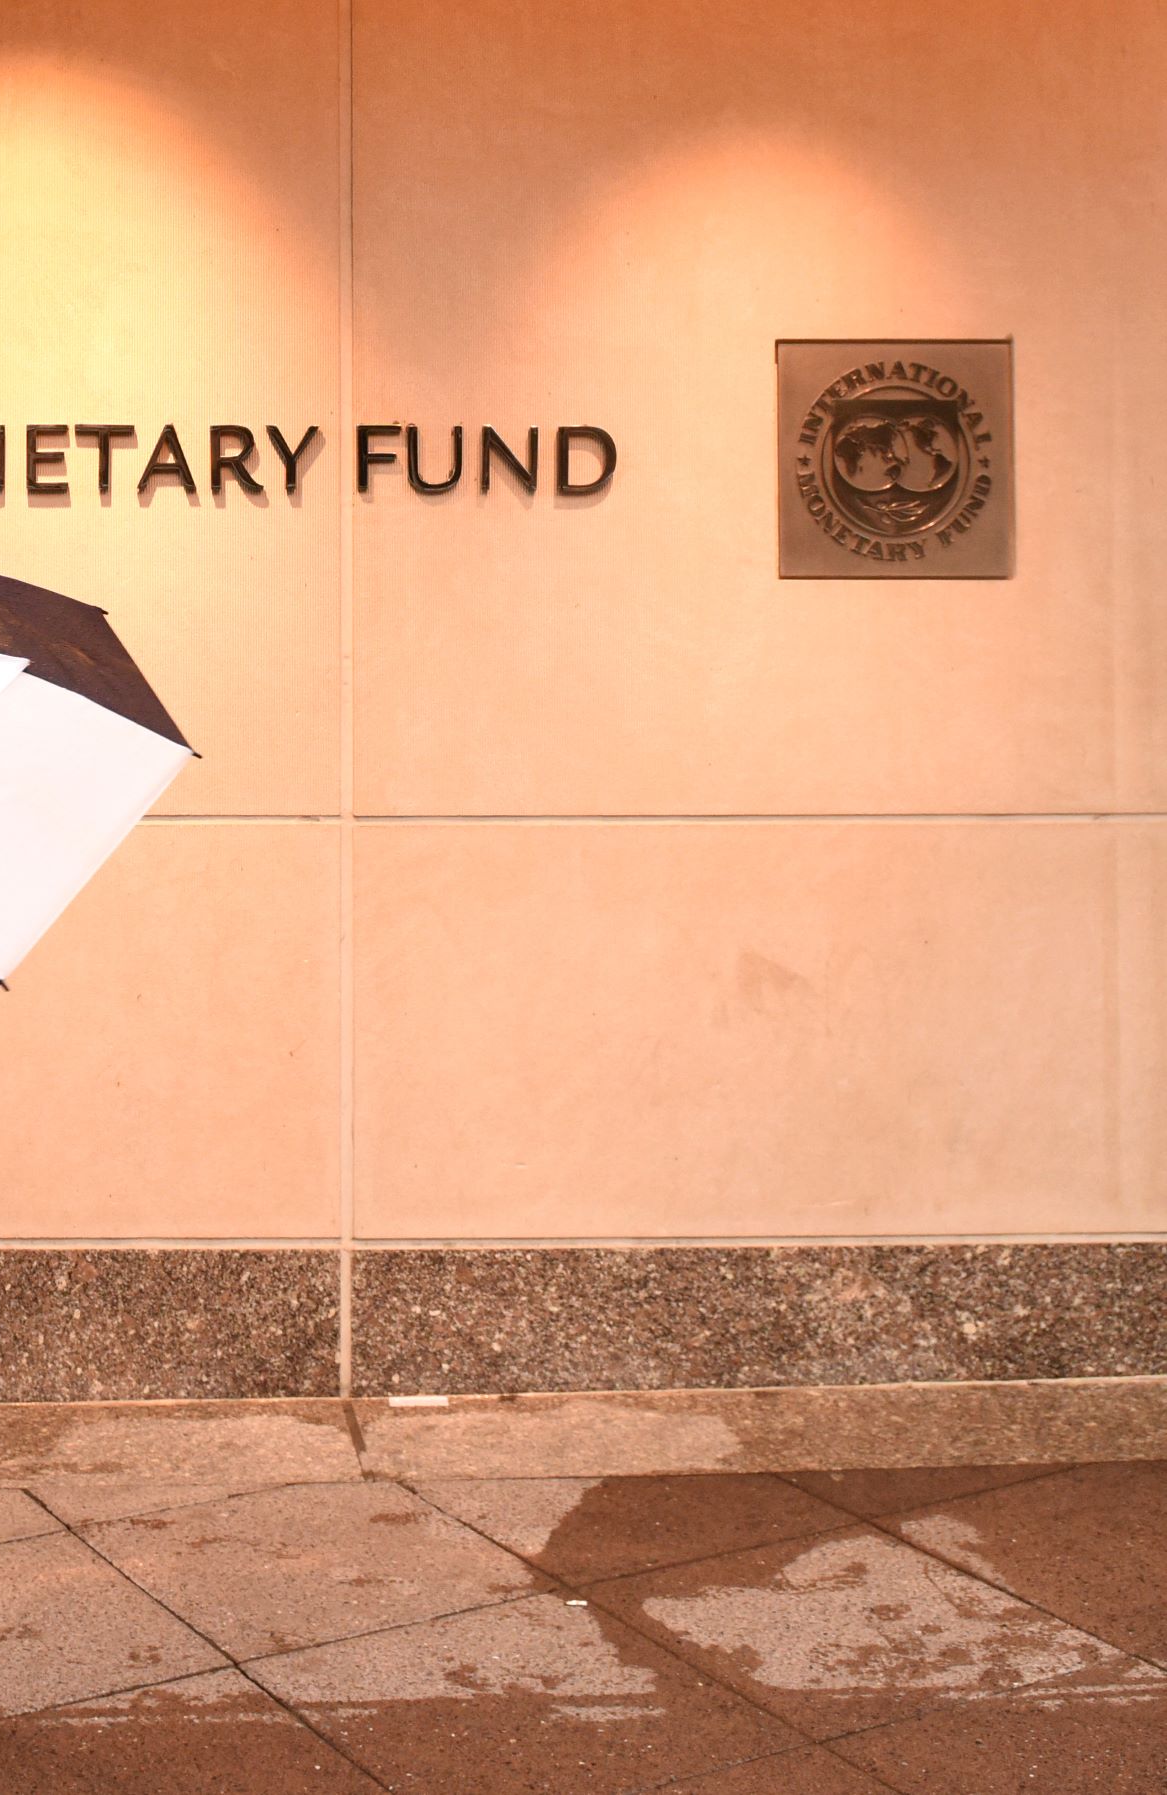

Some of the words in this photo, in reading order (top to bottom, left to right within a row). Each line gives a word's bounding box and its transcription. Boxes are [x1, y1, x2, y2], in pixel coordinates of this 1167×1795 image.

[798, 361, 992, 450] INTERNATIONAL
[356, 424, 618, 495] FUND
[797, 474, 927, 562] MONETARY
[936, 475, 992, 548] FUND
